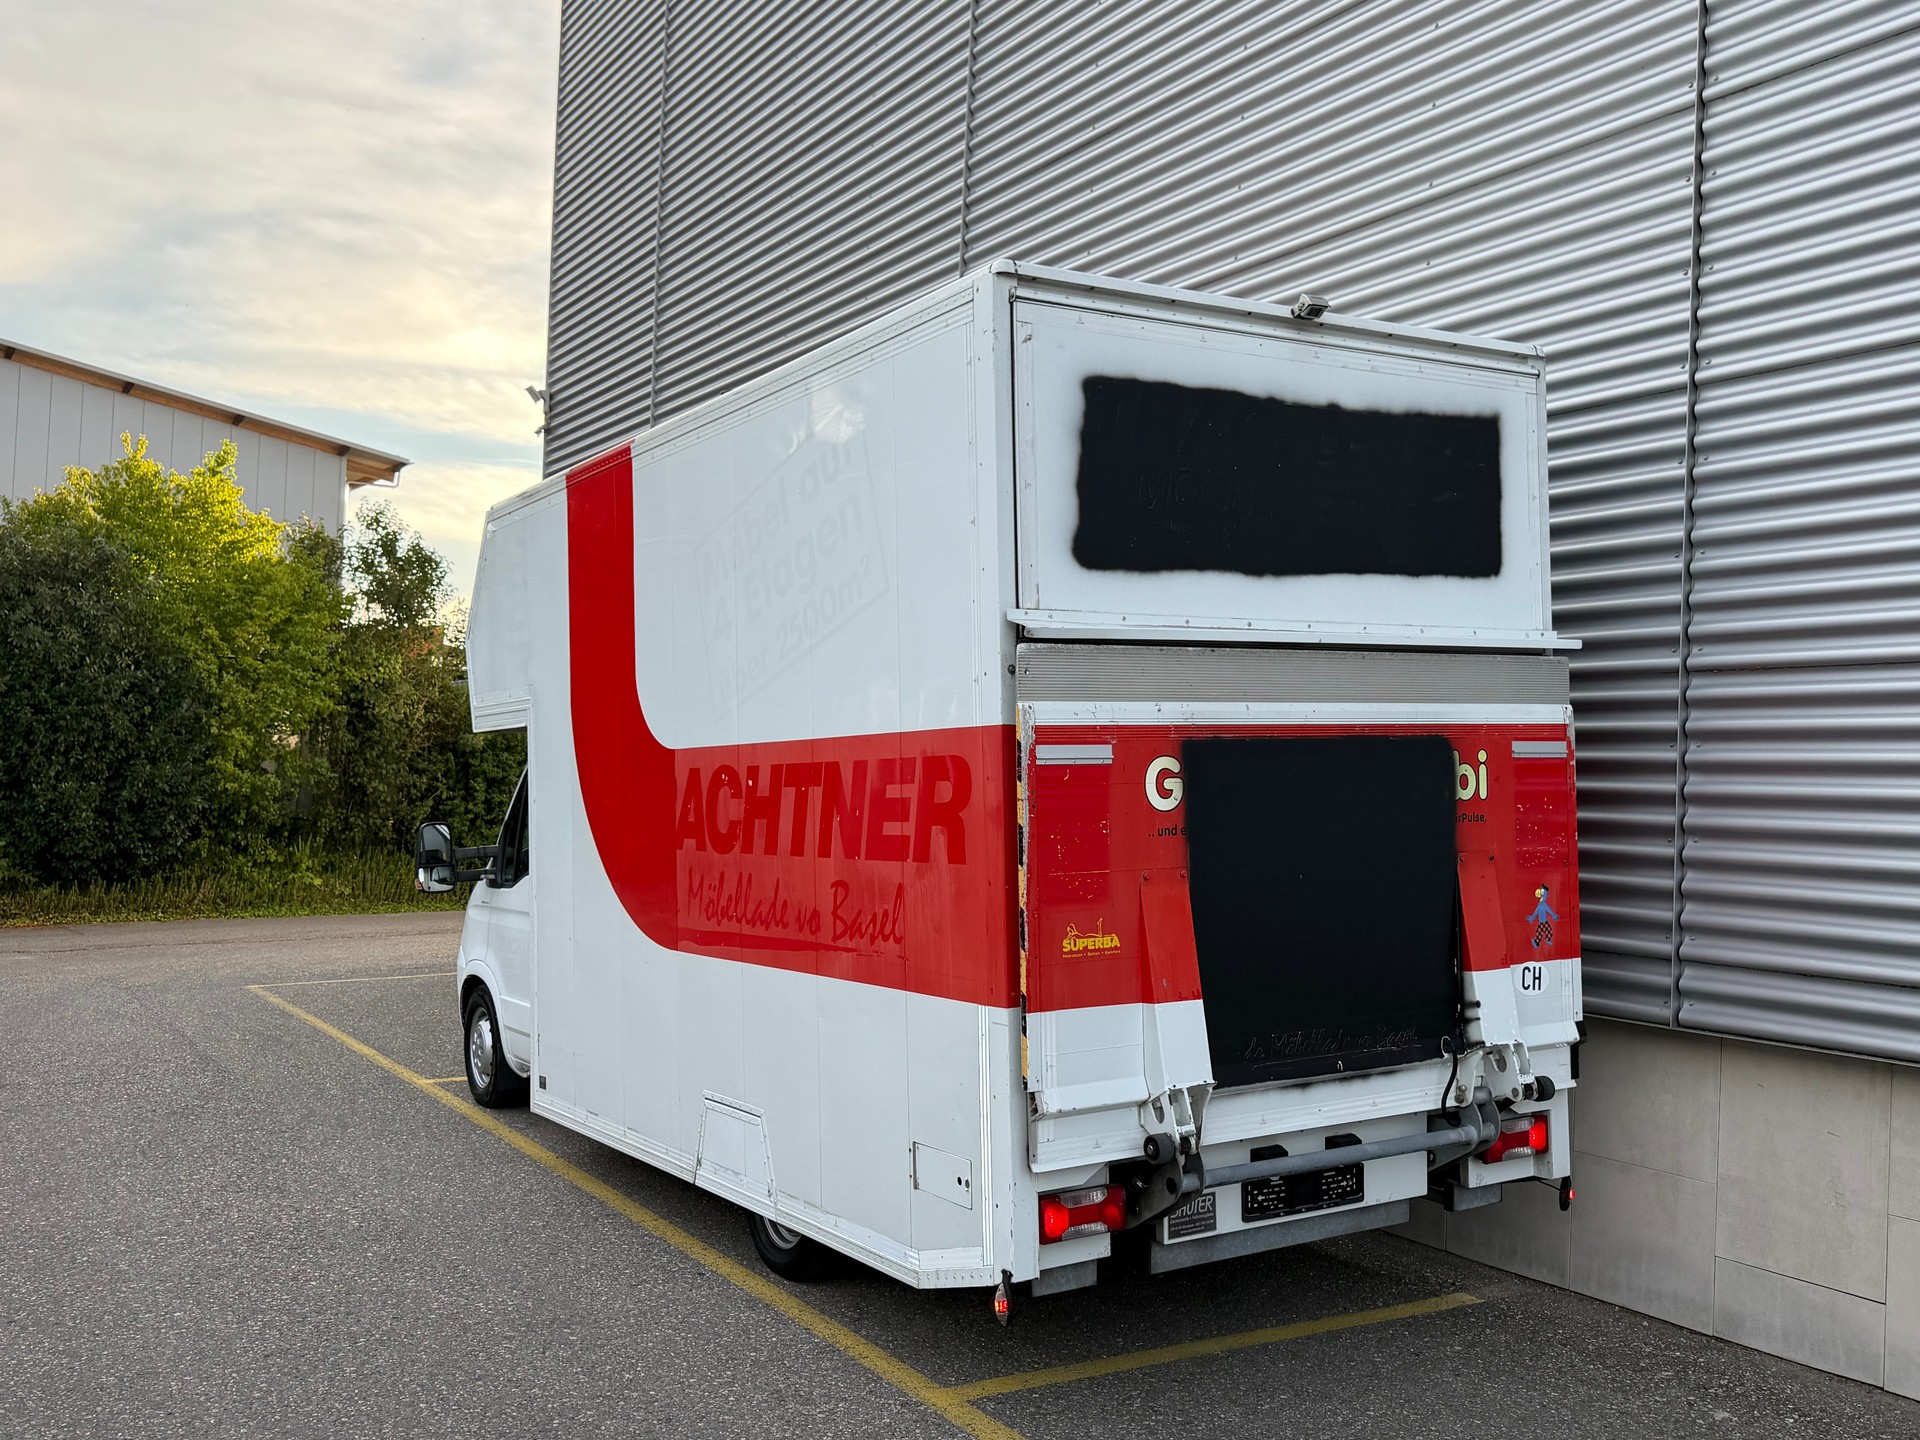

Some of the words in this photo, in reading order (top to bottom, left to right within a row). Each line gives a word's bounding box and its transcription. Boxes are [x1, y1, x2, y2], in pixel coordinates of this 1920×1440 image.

[743, 491, 864, 624] Etagen
[676, 754, 972, 866] ACHTNER
[1144, 754, 1185, 813] G
[1157, 823, 1179, 838] und
[687, 865, 790, 932] Möbellade
[796, 901, 822, 938] vo
[830, 878, 905, 946] Basel
[1062, 933, 1121, 952] SUPERBA
[1521, 966, 1542, 991] CH
